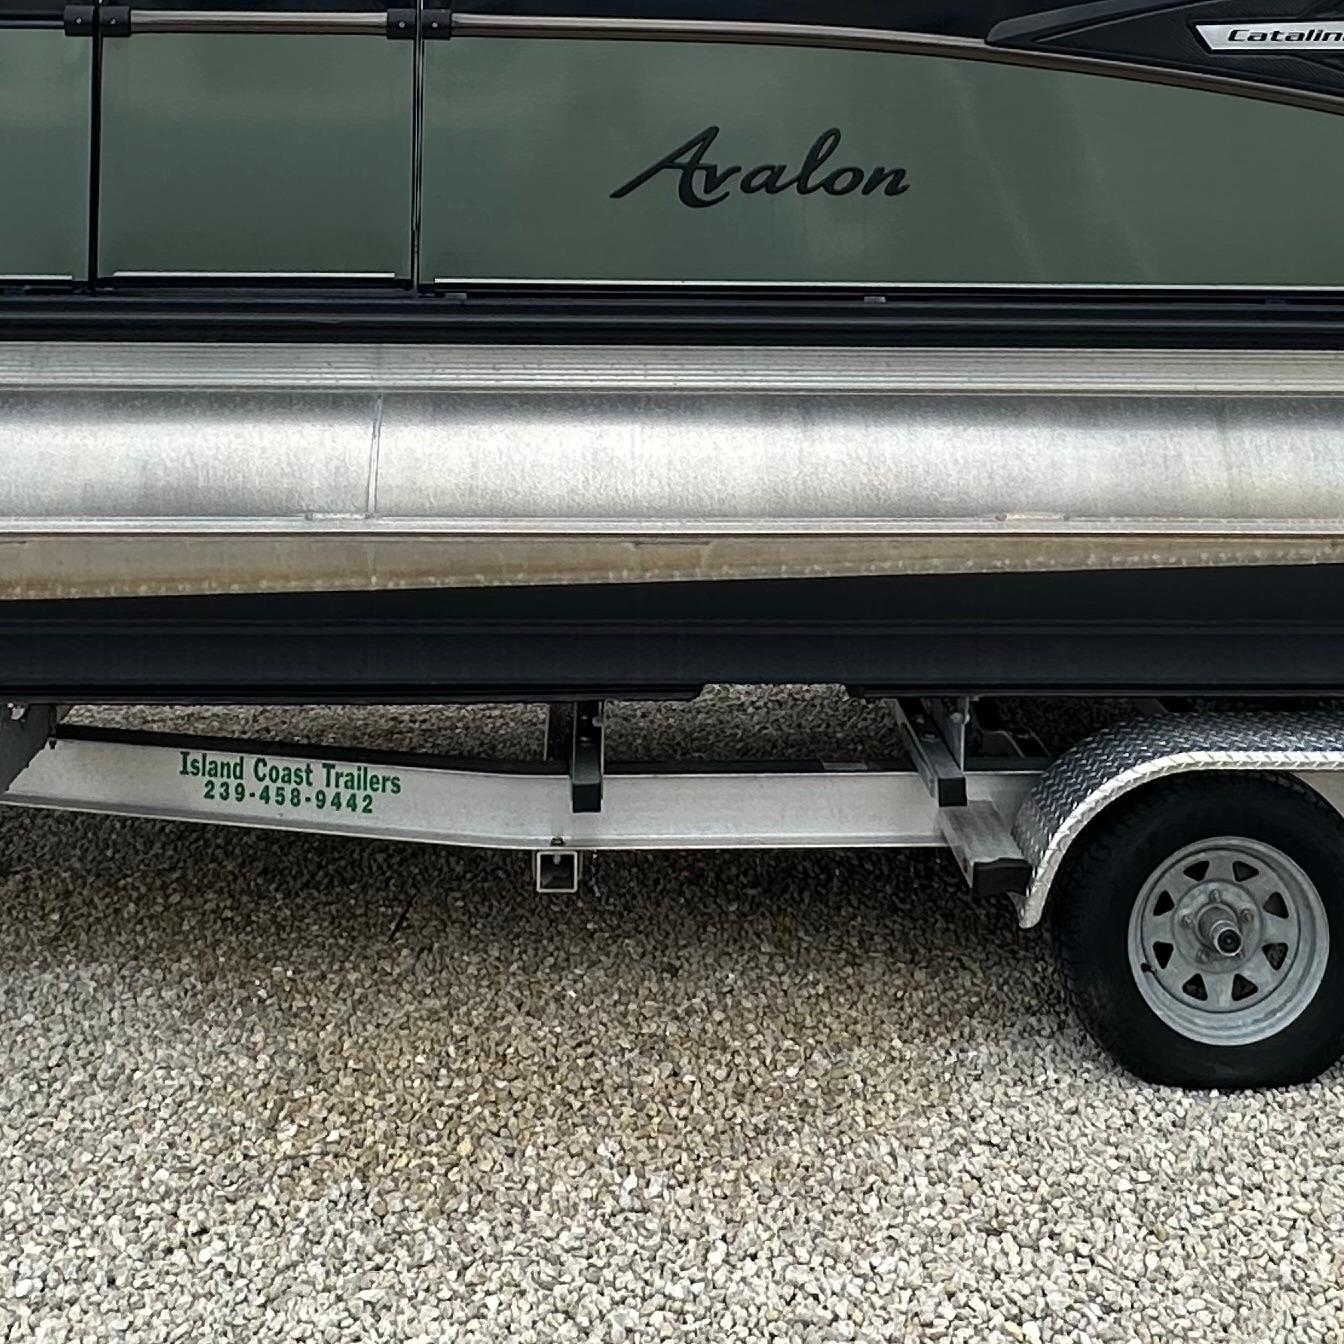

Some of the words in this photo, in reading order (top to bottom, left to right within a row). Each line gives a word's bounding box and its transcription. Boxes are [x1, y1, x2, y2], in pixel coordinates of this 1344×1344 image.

[609, 125, 911, 208] Avalon
[179, 751, 245, 781] Island
[253, 757, 314, 787] Coast
[322, 762, 402, 795] Trailers
[203, 780, 374, 814] 239-458-9442
